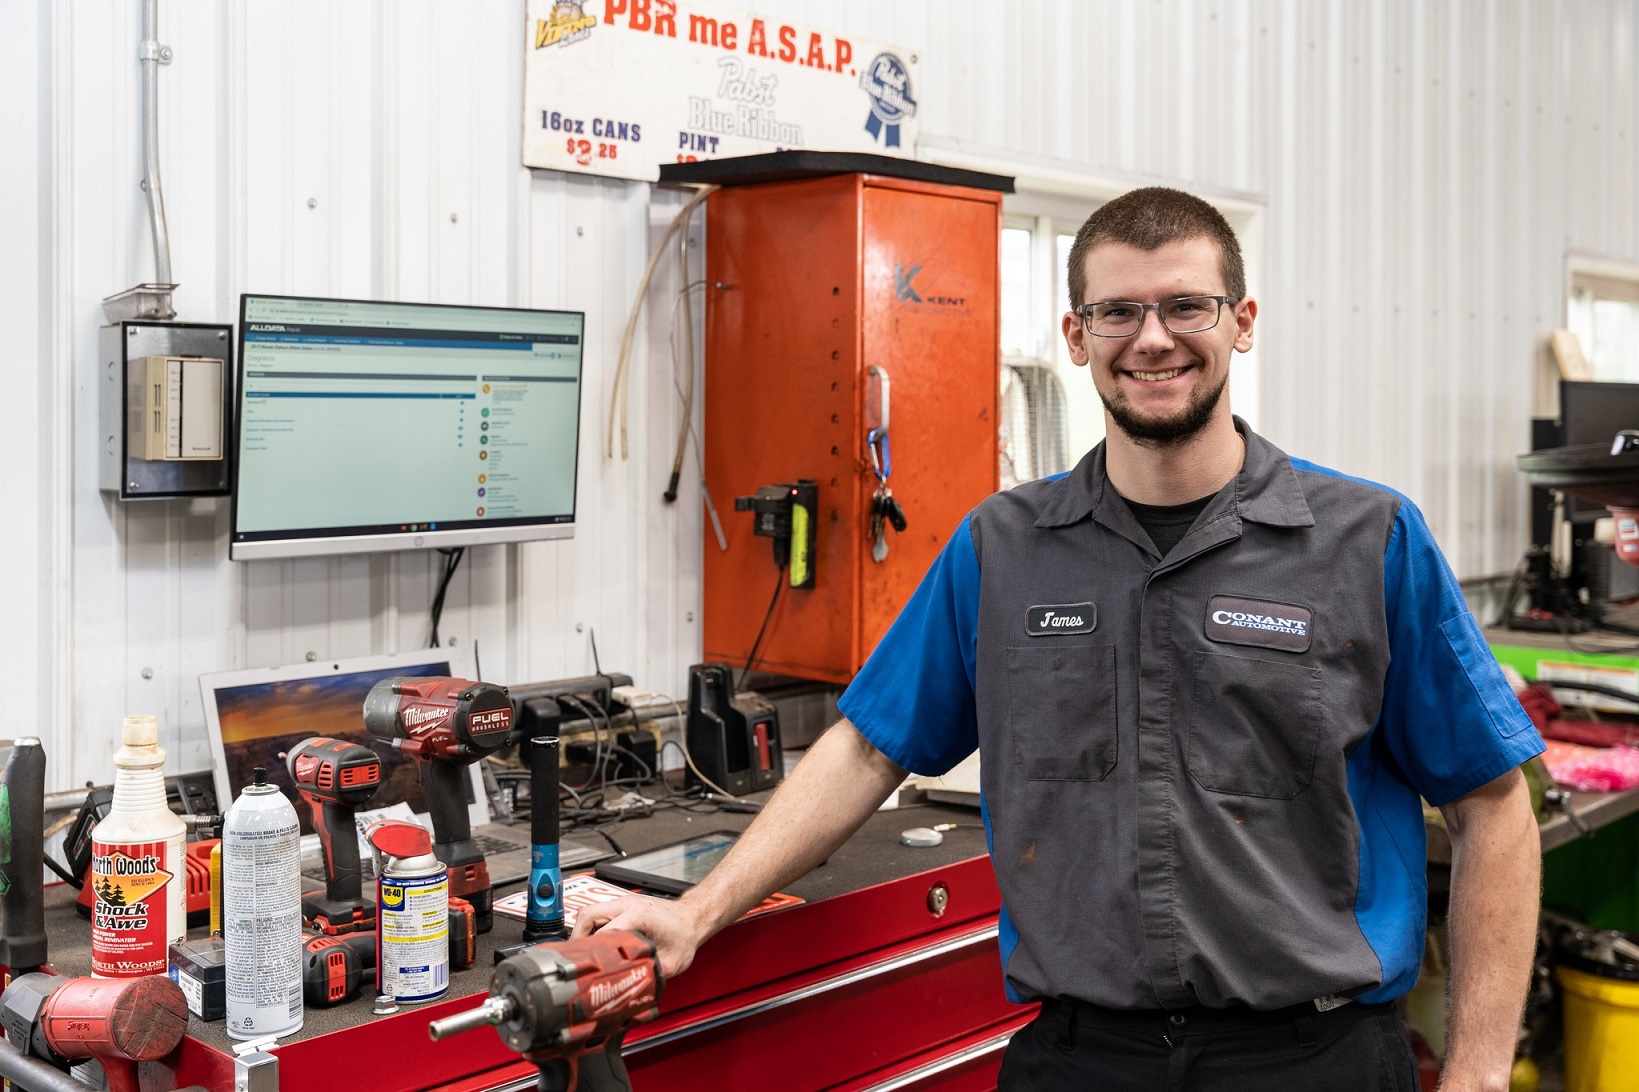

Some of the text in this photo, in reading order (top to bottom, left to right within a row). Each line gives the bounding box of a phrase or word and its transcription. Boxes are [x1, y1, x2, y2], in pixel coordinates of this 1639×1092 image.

[603, 0, 857, 77] PBR me A.S.A.P.
[717, 55, 778, 107] Pabst
[541, 109, 642, 142] 16oz CANS
[687, 96, 804, 147] Blue Ribbon
[678, 130, 719, 154] PINT
[250, 323, 286, 333] ALLDATA
[1040, 611, 1085, 628] James
[1231, 620, 1306, 636] AUTOMOTIVE
[403, 707, 449, 728] Milwaukee
[472, 712, 509, 726] FUEL
[383, 888, 402, 898] WD-40
[95, 902, 148, 917] Shock
[589, 965, 647, 1006] Milwaukee
